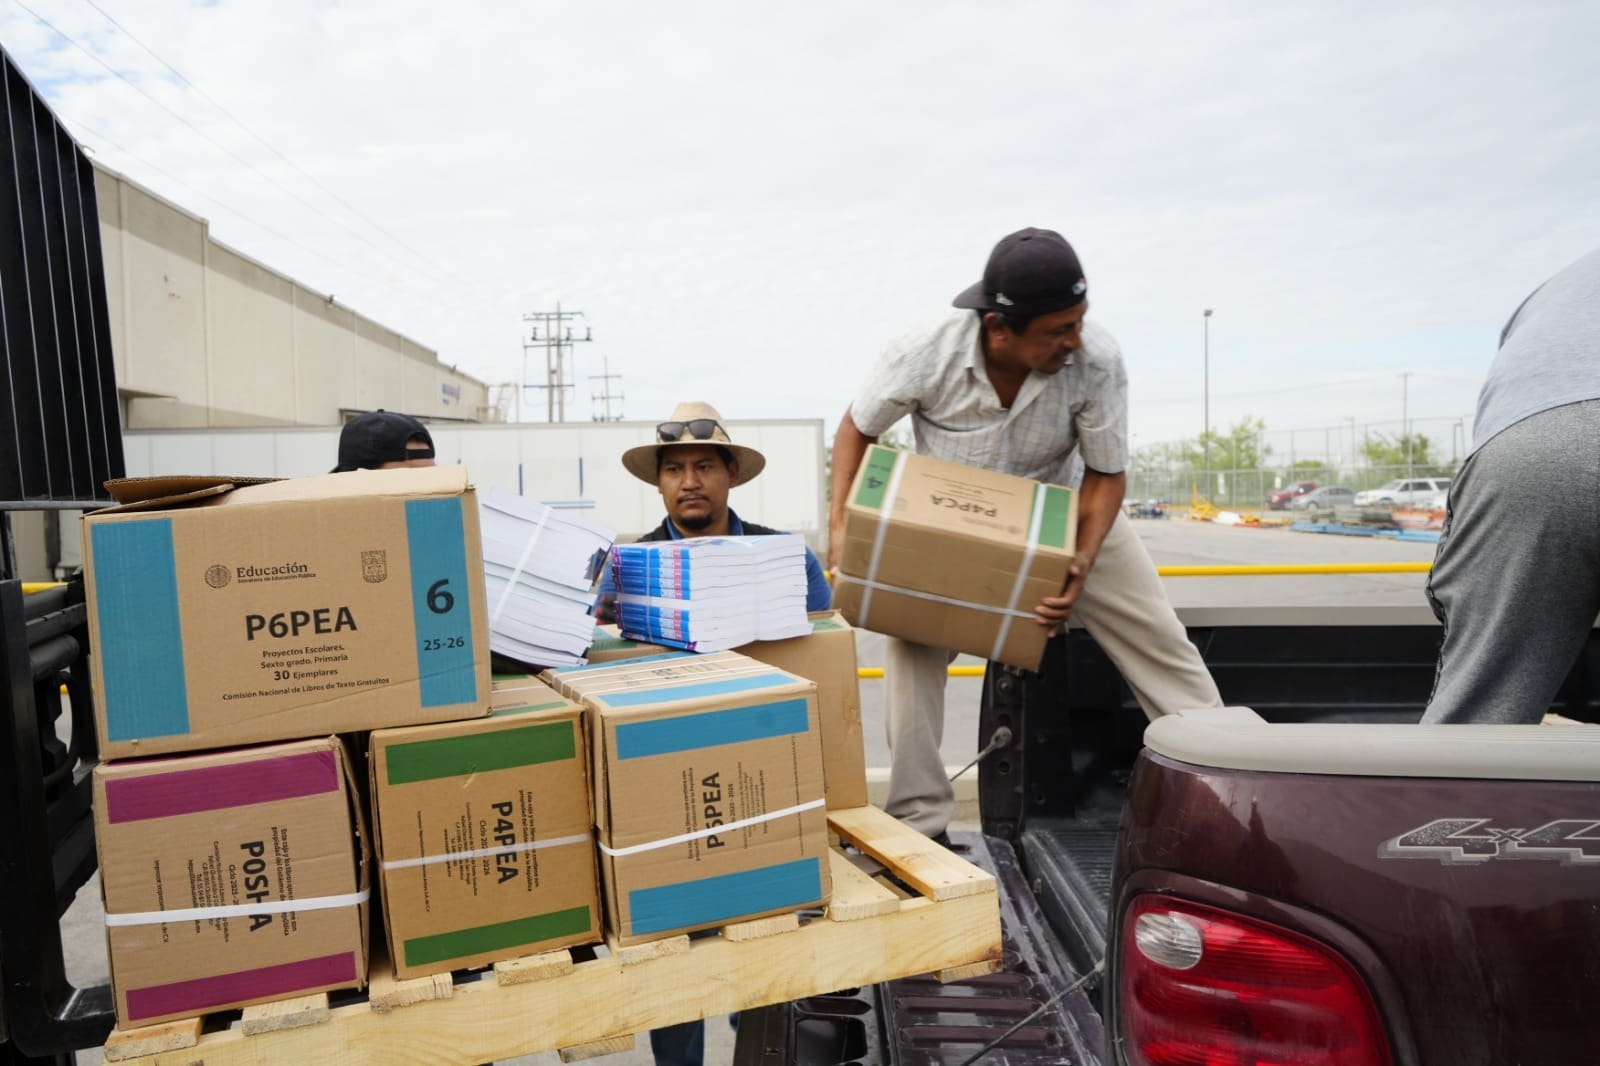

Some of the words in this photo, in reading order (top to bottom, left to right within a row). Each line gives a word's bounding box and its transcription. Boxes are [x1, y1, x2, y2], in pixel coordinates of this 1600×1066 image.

[866, 476, 884, 490] 4
[929, 494, 998, 518] P4PCA
[236, 563, 308, 577] Educación
[427, 578, 454, 614] 6
[245, 606, 357, 640] P6PEA
[424, 636, 465, 651] 25-26
[260, 659, 284, 668] Sexto
[314, 653, 348, 663] Primaria
[262, 647, 303, 659] Proyectos
[273, 669, 290, 680] 30
[293, 667, 338, 679] Ejemplares
[222, 690, 256, 700] Comisión
[258, 687, 290, 696] Nacional
[302, 683, 324, 692] Libros
[336, 680, 355, 688] Texto
[356, 676, 389, 686] Gratuitos
[491, 800, 519, 884] P4PEA
